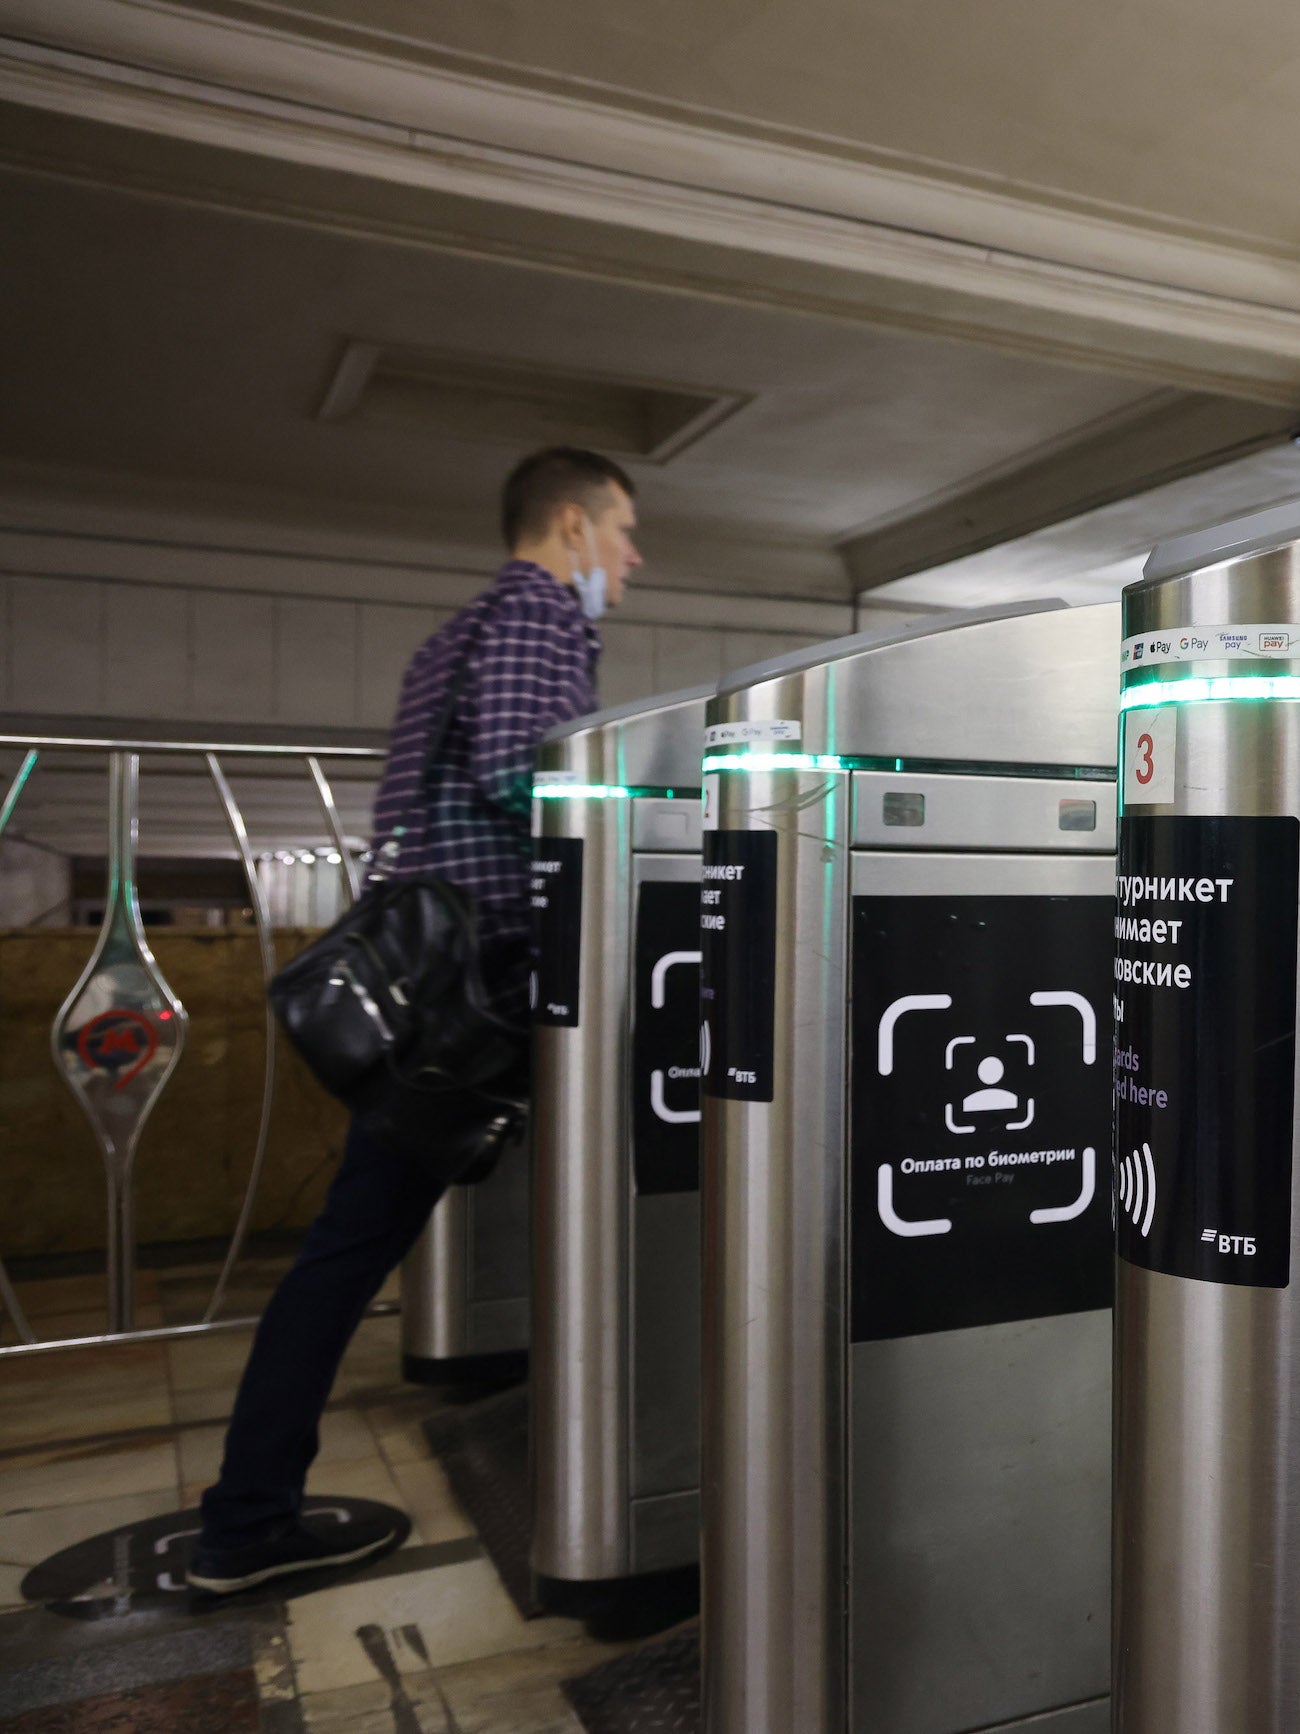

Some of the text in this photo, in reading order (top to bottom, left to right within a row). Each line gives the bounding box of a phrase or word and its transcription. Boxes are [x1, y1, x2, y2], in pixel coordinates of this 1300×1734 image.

[1156, 641, 1172, 654] Pay
[1191, 637, 1209, 651] Pay
[1224, 641, 1242, 650] pay
[1262, 640, 1284, 649] pay
[1135, 733, 1154, 785] 3
[1119, 876, 1234, 907] турникет
[735, 1070, 757, 1084] ВТБ
[1129, 1076, 1168, 1109] here
[900, 1148, 1076, 1174] Оплата по биометрии
[966, 1172, 1015, 1186] Face Pay
[1218, 1234, 1257, 1256] ВТБ
